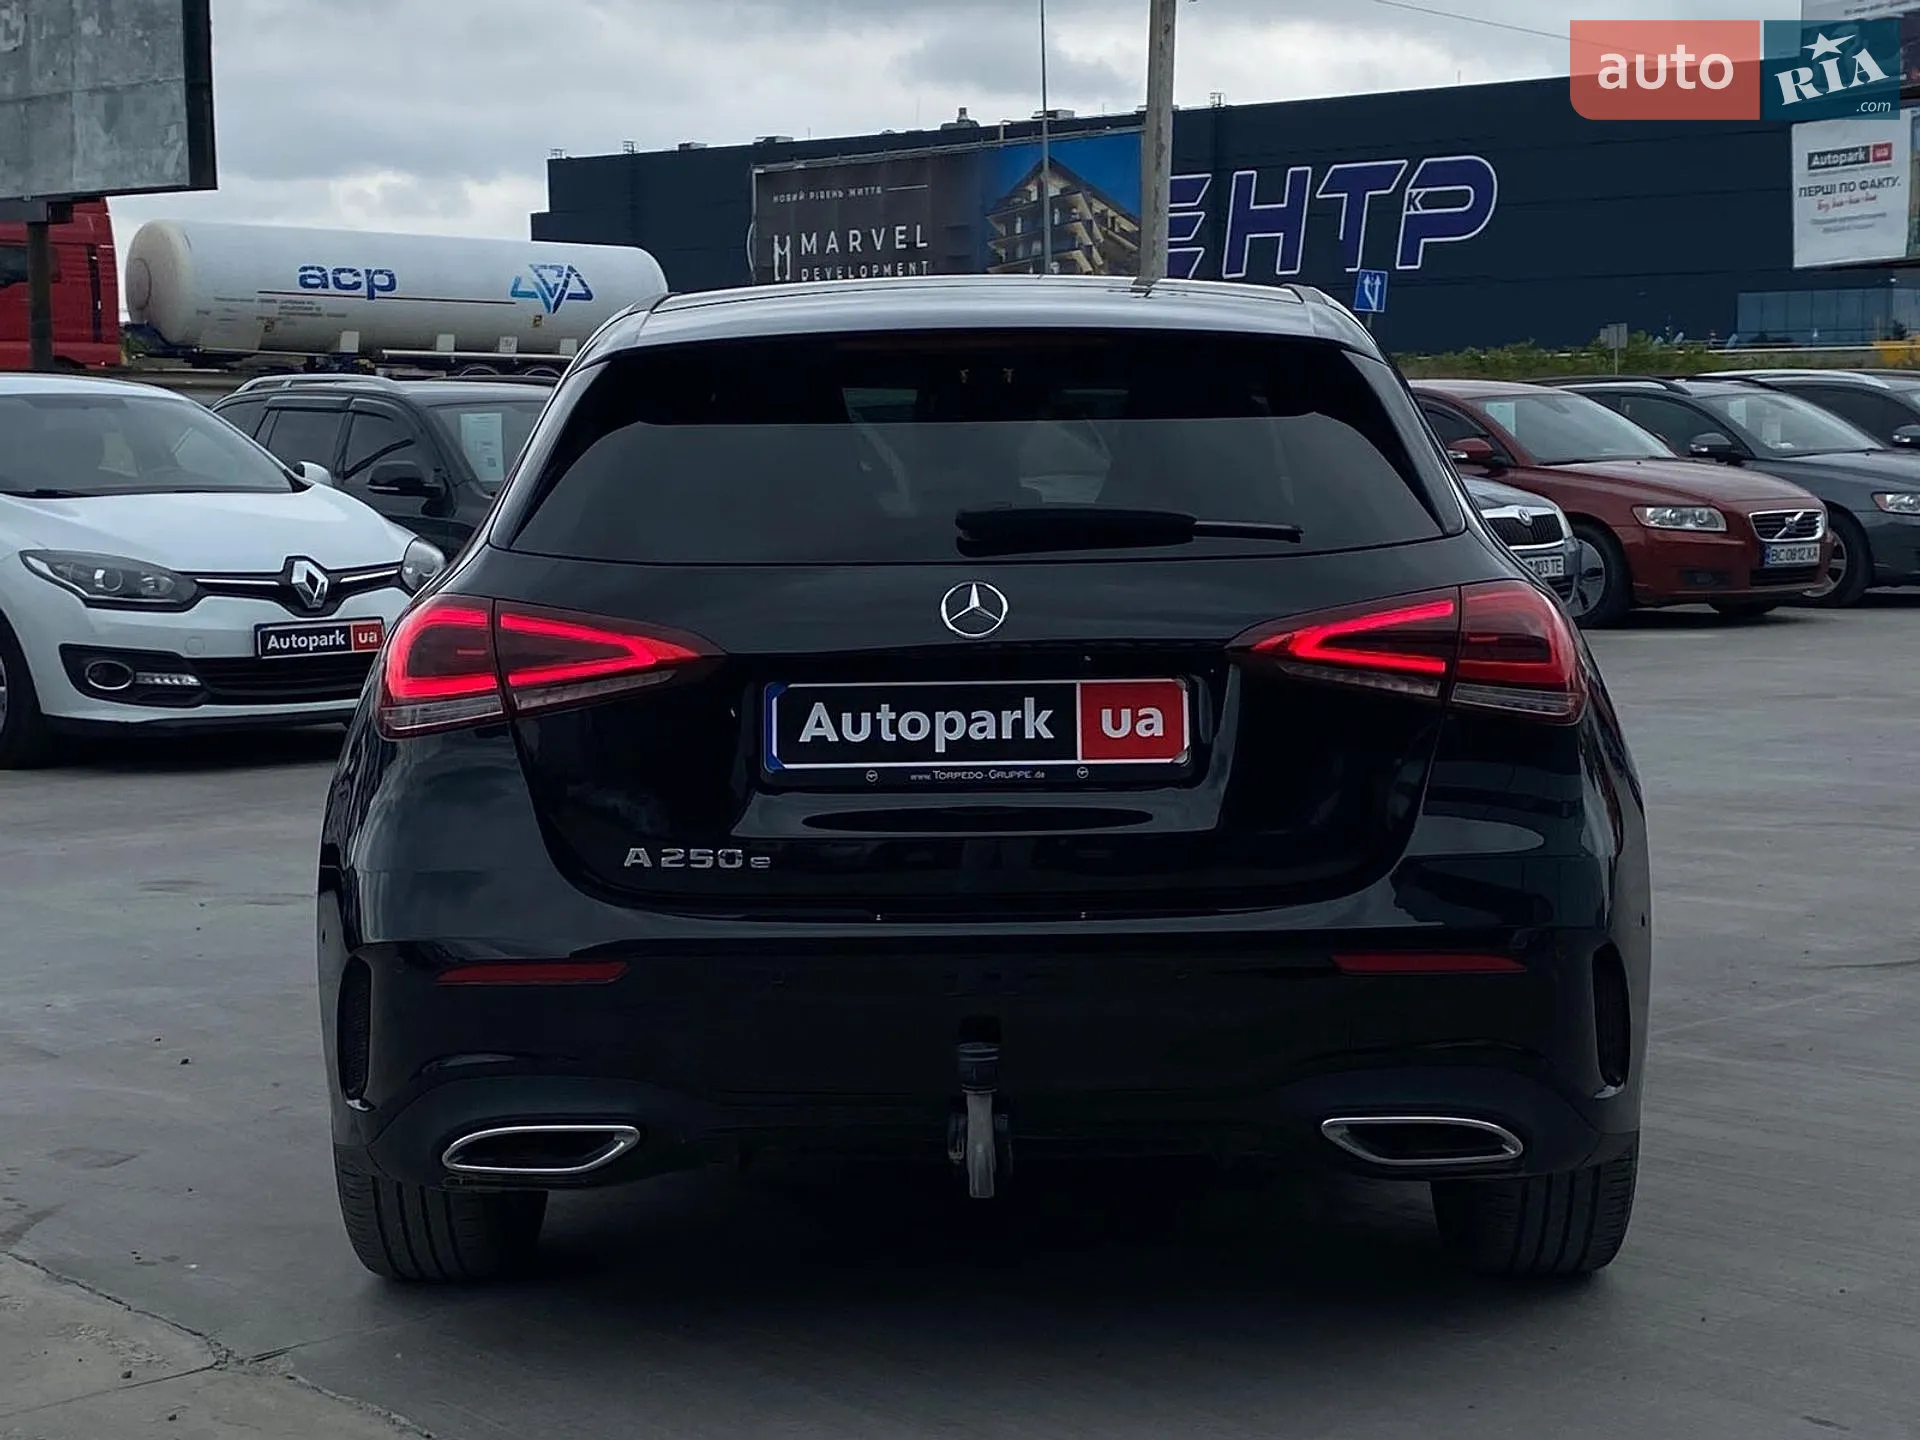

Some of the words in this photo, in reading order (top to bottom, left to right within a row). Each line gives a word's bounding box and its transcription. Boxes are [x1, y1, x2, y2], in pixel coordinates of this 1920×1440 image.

[1811, 149, 1865, 167] Autopark
[1799, 183, 1836, 197] ПЕРШІ
[1840, 181, 1857, 193] ПО
[801, 225, 928, 255] MARVEL
[801, 261, 929, 281] DEVELOPMENT
[267, 630, 345, 651] Autopark
[358, 631, 378, 644] ua
[798, 697, 1054, 753] Autopark
[1100, 707, 1164, 738] ua
[624, 848, 652, 867] A
